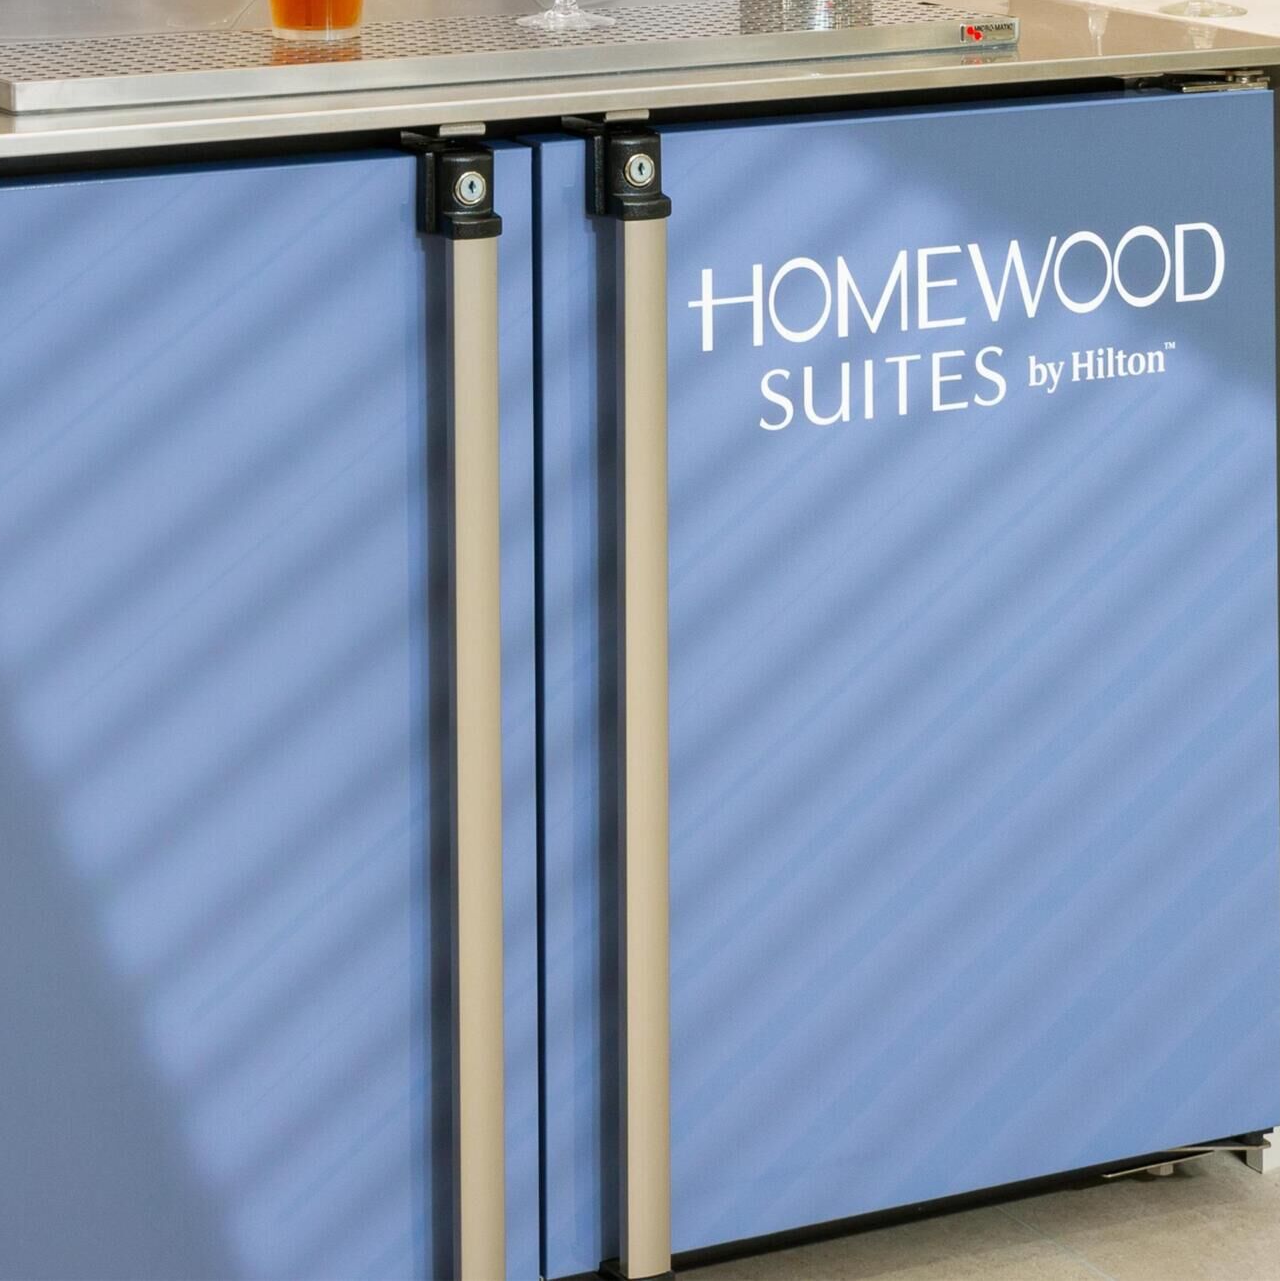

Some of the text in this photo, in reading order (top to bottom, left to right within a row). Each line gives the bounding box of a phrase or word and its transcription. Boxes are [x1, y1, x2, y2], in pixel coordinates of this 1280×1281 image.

[687, 221, 1226, 352] HOMEWOOD
[758, 345, 1008, 431] SUITES
[1027, 355, 1065, 394] by
